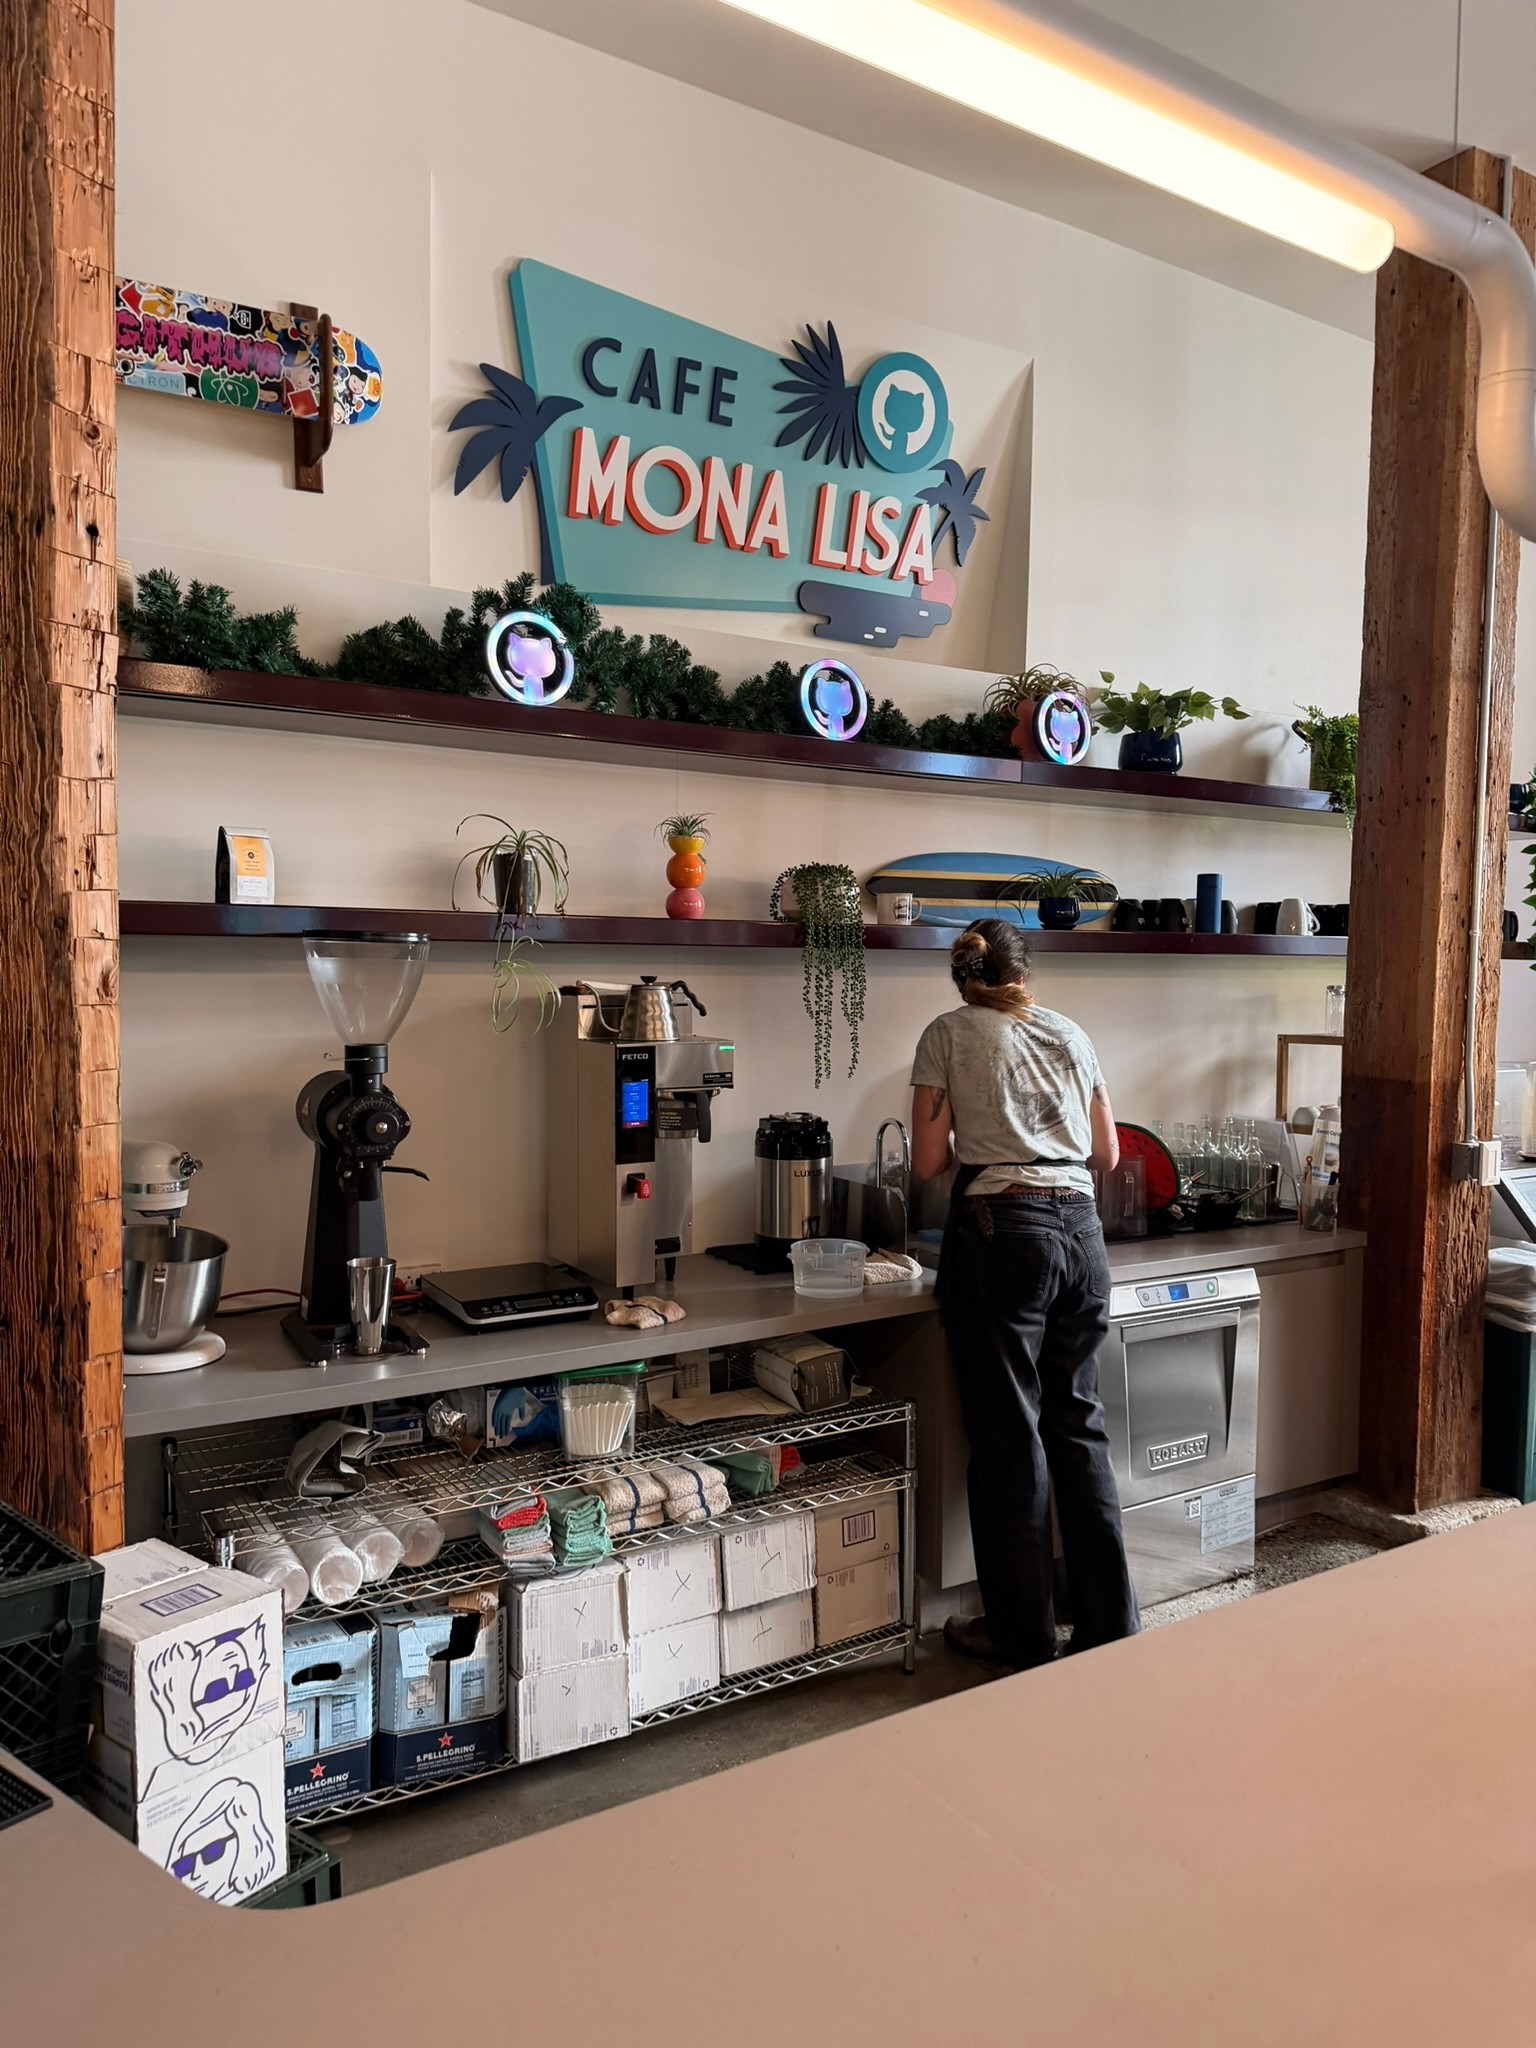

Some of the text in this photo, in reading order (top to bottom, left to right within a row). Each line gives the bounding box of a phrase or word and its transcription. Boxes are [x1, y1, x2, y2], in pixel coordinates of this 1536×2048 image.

[116, 308, 283, 383] GITHUB
[582, 337, 739, 428] CAFE
[567, 426, 936, 586] MONA LISA
[794, 1169, 823, 1178] LUXUS
[1153, 1441, 1204, 1463] HOBART
[416, 1744, 476, 1763] S.PELLEGRINO
